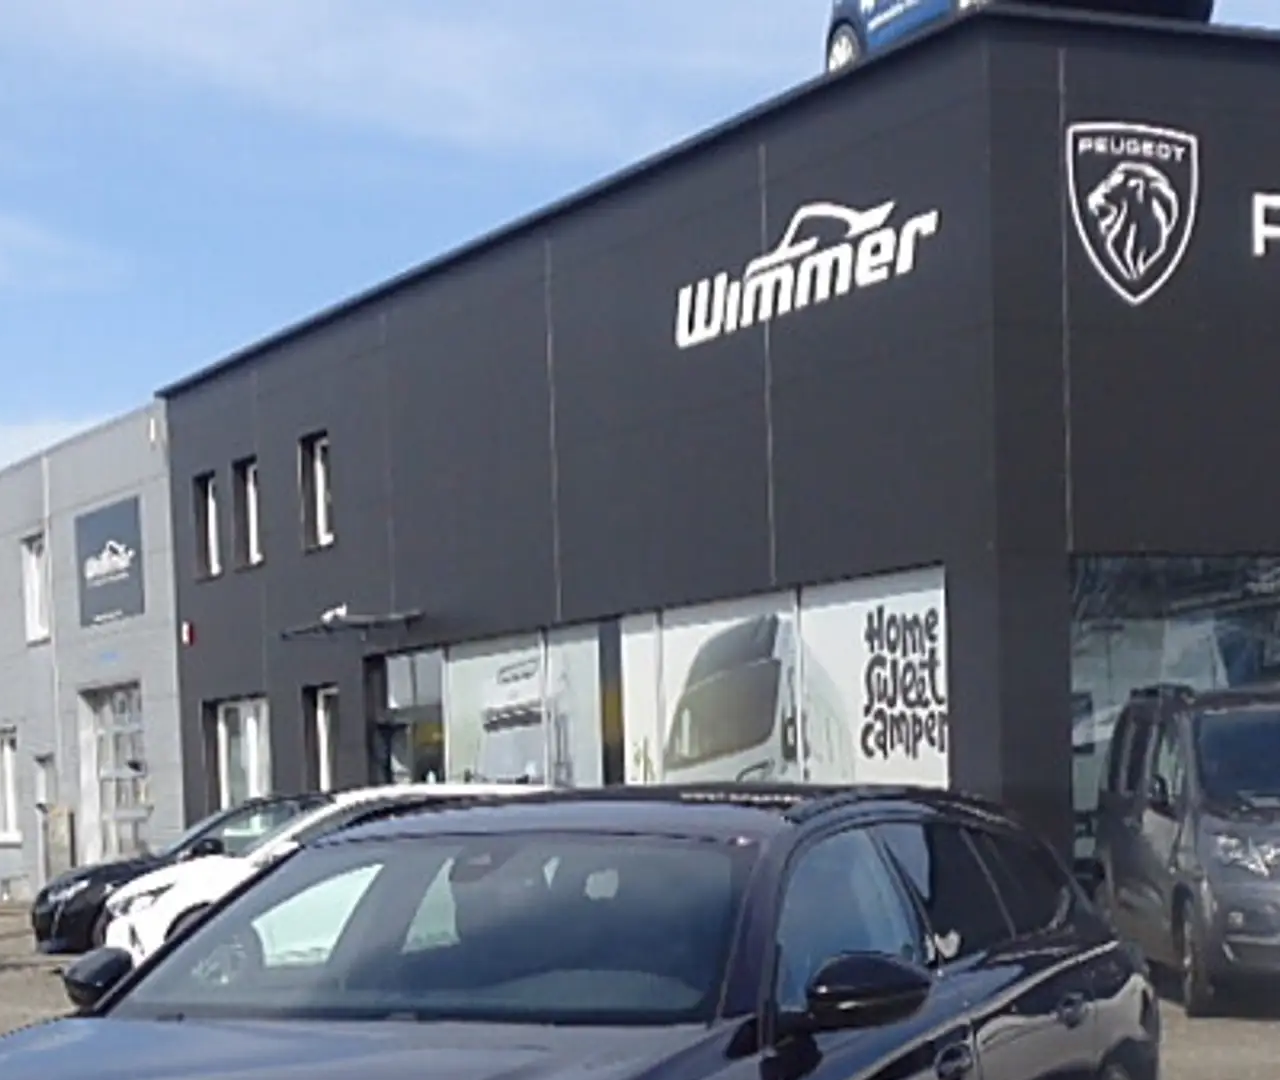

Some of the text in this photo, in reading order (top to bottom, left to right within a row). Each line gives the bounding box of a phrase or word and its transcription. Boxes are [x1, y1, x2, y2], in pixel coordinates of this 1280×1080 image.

[1077, 136, 1186, 161] PEUGEOT
[675, 208, 939, 350] Wimmer
[864, 604, 939, 657] Home
